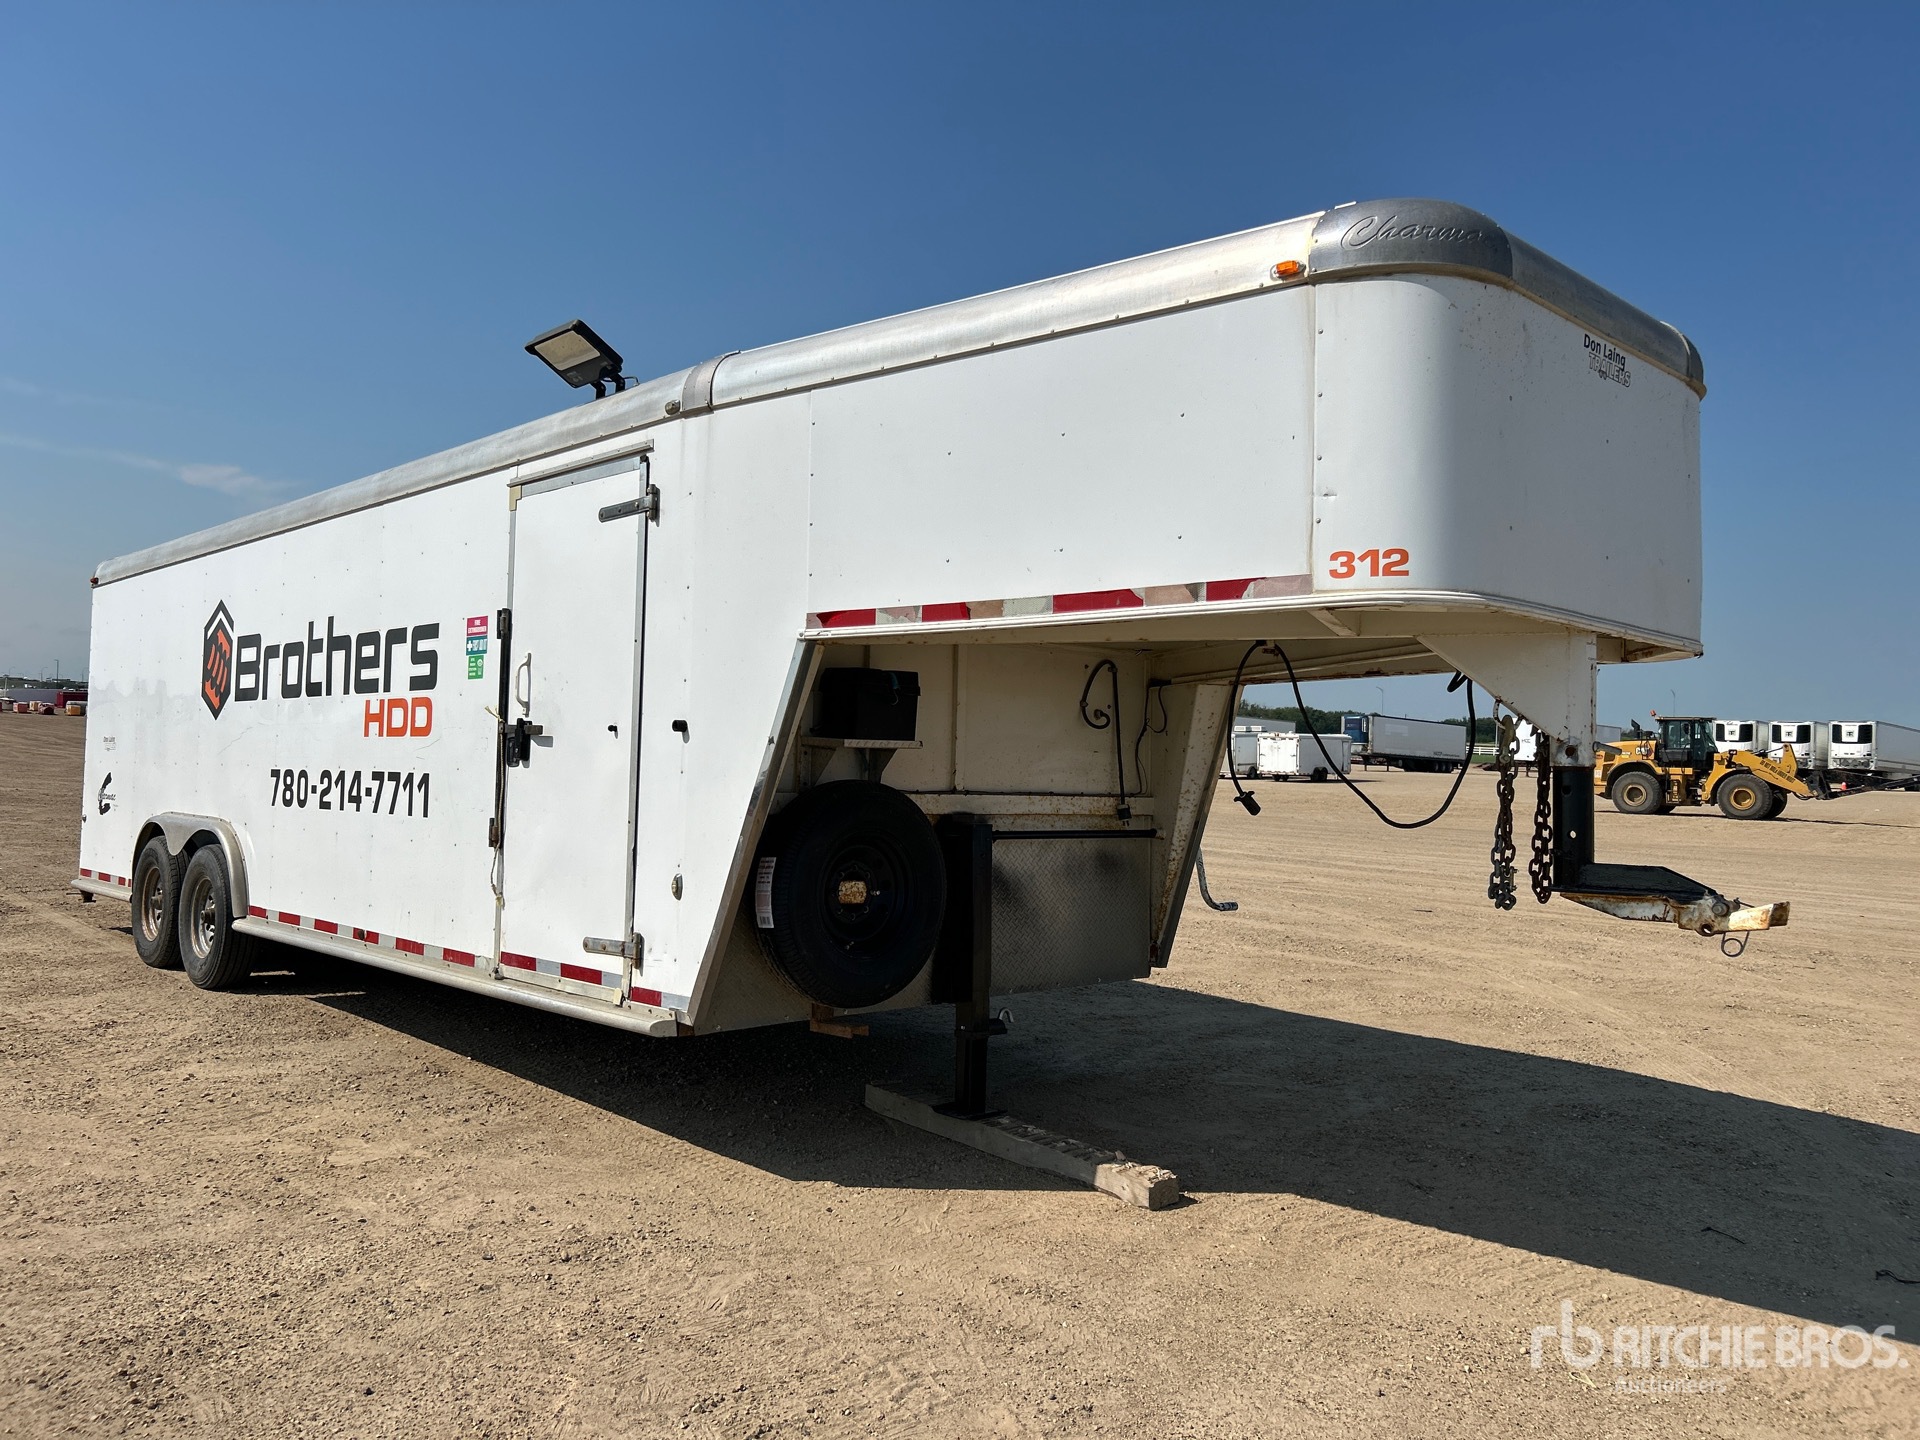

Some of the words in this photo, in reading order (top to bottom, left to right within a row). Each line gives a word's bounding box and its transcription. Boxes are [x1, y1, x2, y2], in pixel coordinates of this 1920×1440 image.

[1584, 333, 1601, 355] Don
[1603, 343, 1626, 371] Laing
[1589, 351, 1631, 388] TRAILERS
[1329, 548, 1410, 579] 312
[234, 616, 440, 702] Brothers
[363, 697, 433, 738] HDD
[270, 769, 430, 818] 780-214-7711
